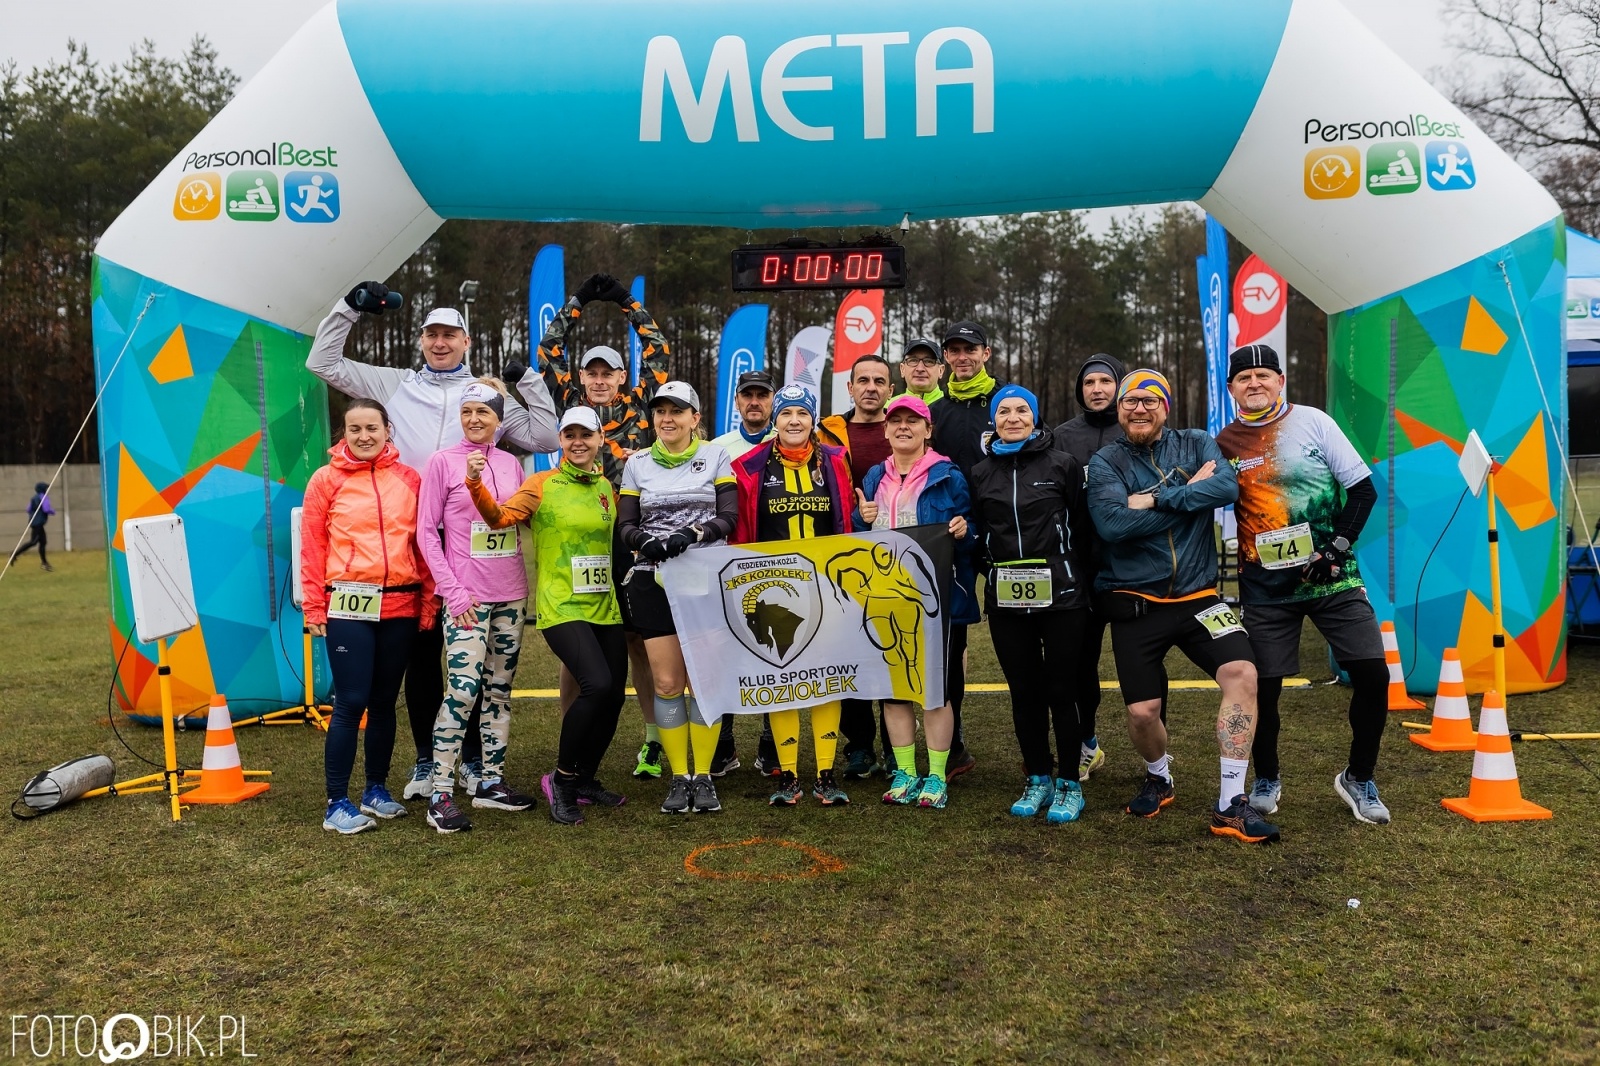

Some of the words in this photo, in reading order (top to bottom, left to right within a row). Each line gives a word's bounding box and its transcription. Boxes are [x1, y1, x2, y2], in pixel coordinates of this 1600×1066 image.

[639, 26, 995, 143] META
[1304, 114, 1465, 144] PersonalBest
[182, 142, 338, 172] PersonalBest
[763, 254, 883, 282] 0:00:00
[769, 502, 830, 514] KOZIOŁEK
[486, 533, 507, 550] 57
[1272, 539, 1299, 560] 74
[737, 557, 798, 571] KĘDZIERZYN-KOŹLE
[582, 568, 607, 585] 155
[733, 574, 747, 586] KS
[750, 569, 803, 581] KOZIOŁEK
[1011, 582, 1037, 599] 98
[338, 594, 373, 612] 107
[1212, 612, 1238, 627] 18
[738, 674, 776, 687] KLUB
[780, 664, 859, 683] SPORTOWY
[740, 675, 858, 706] KOZIOŁEK
